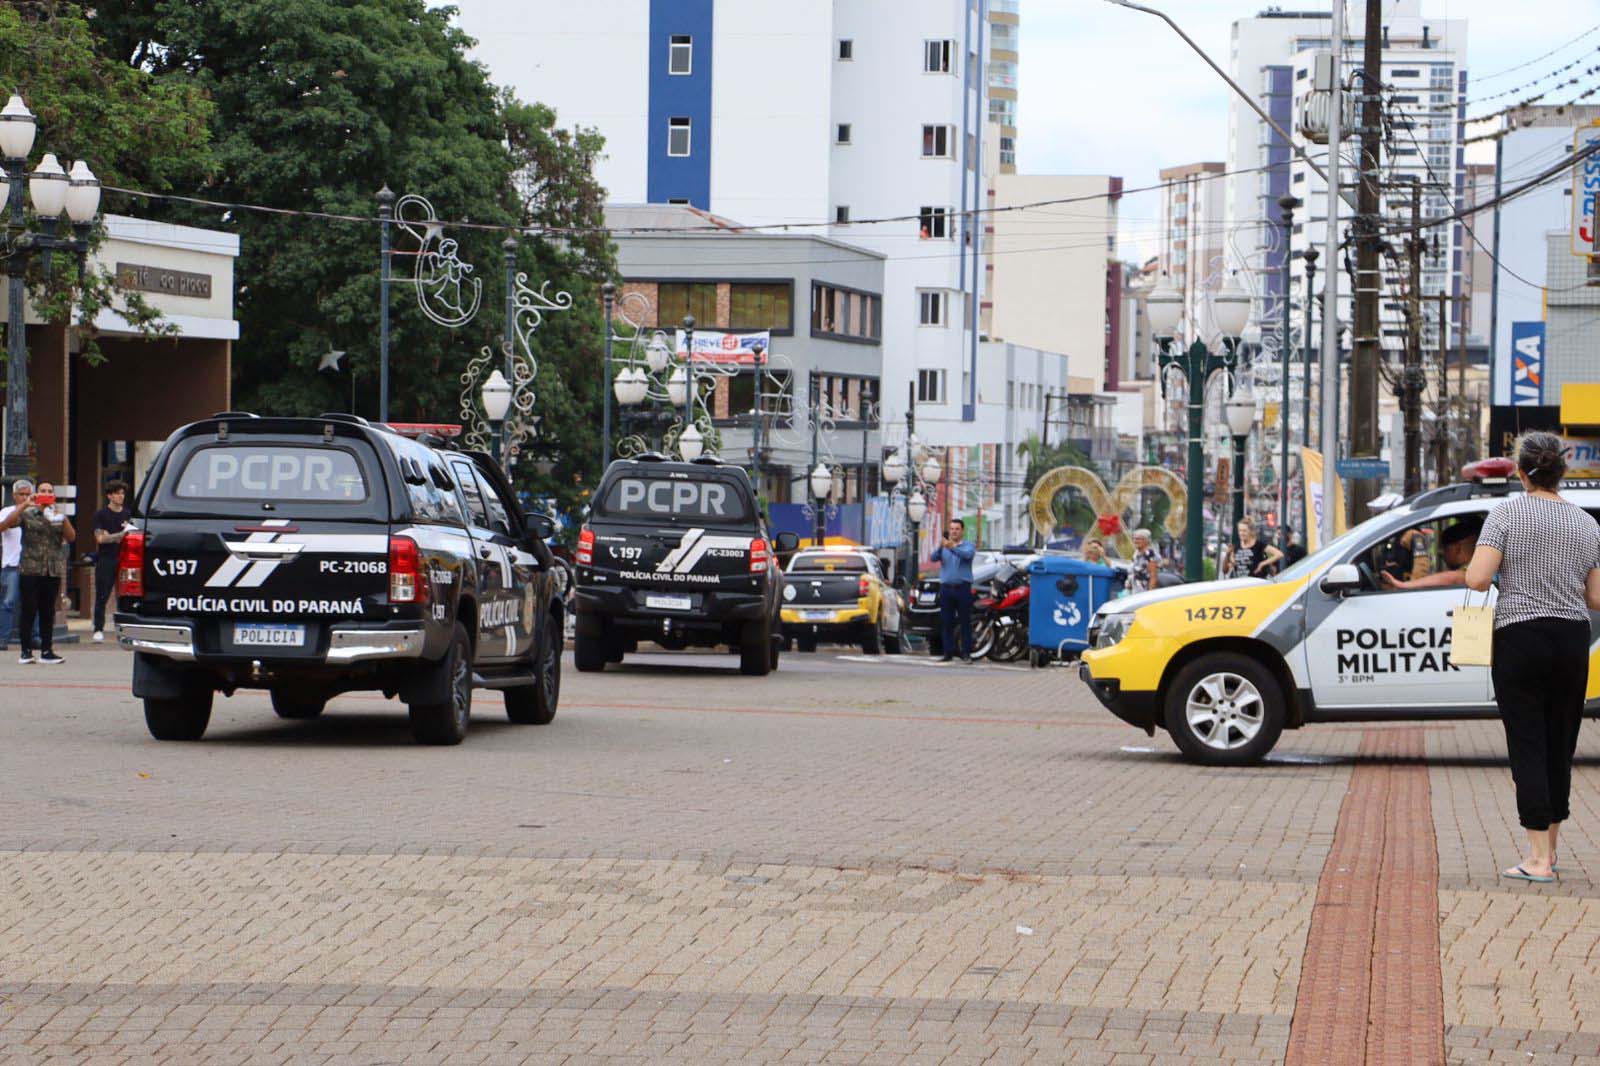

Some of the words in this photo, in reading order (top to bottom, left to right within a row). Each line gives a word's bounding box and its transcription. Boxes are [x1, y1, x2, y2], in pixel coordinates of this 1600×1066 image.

[208, 455, 333, 491] PCPR
[619, 479, 726, 515] PCPR
[620, 547, 642, 559] 197
[166, 559, 198, 576] 197
[319, 560, 387, 574] PC-21068
[620, 570, 651, 580] POLÍCIA
[652, 572, 672, 581] CIVIL
[673, 573, 686, 582] DO
[687, 573, 720, 583] PARANÁ
[167, 594, 228, 612] POLÍCIA
[230, 599, 269, 613] CIVIL
[273, 599, 297, 614] DO
[299, 598, 364, 614] PARANÁ
[1184, 606, 1247, 622] 14787
[241, 629, 297, 643] POLICIA
[1352, 674, 1375, 683] BPM
